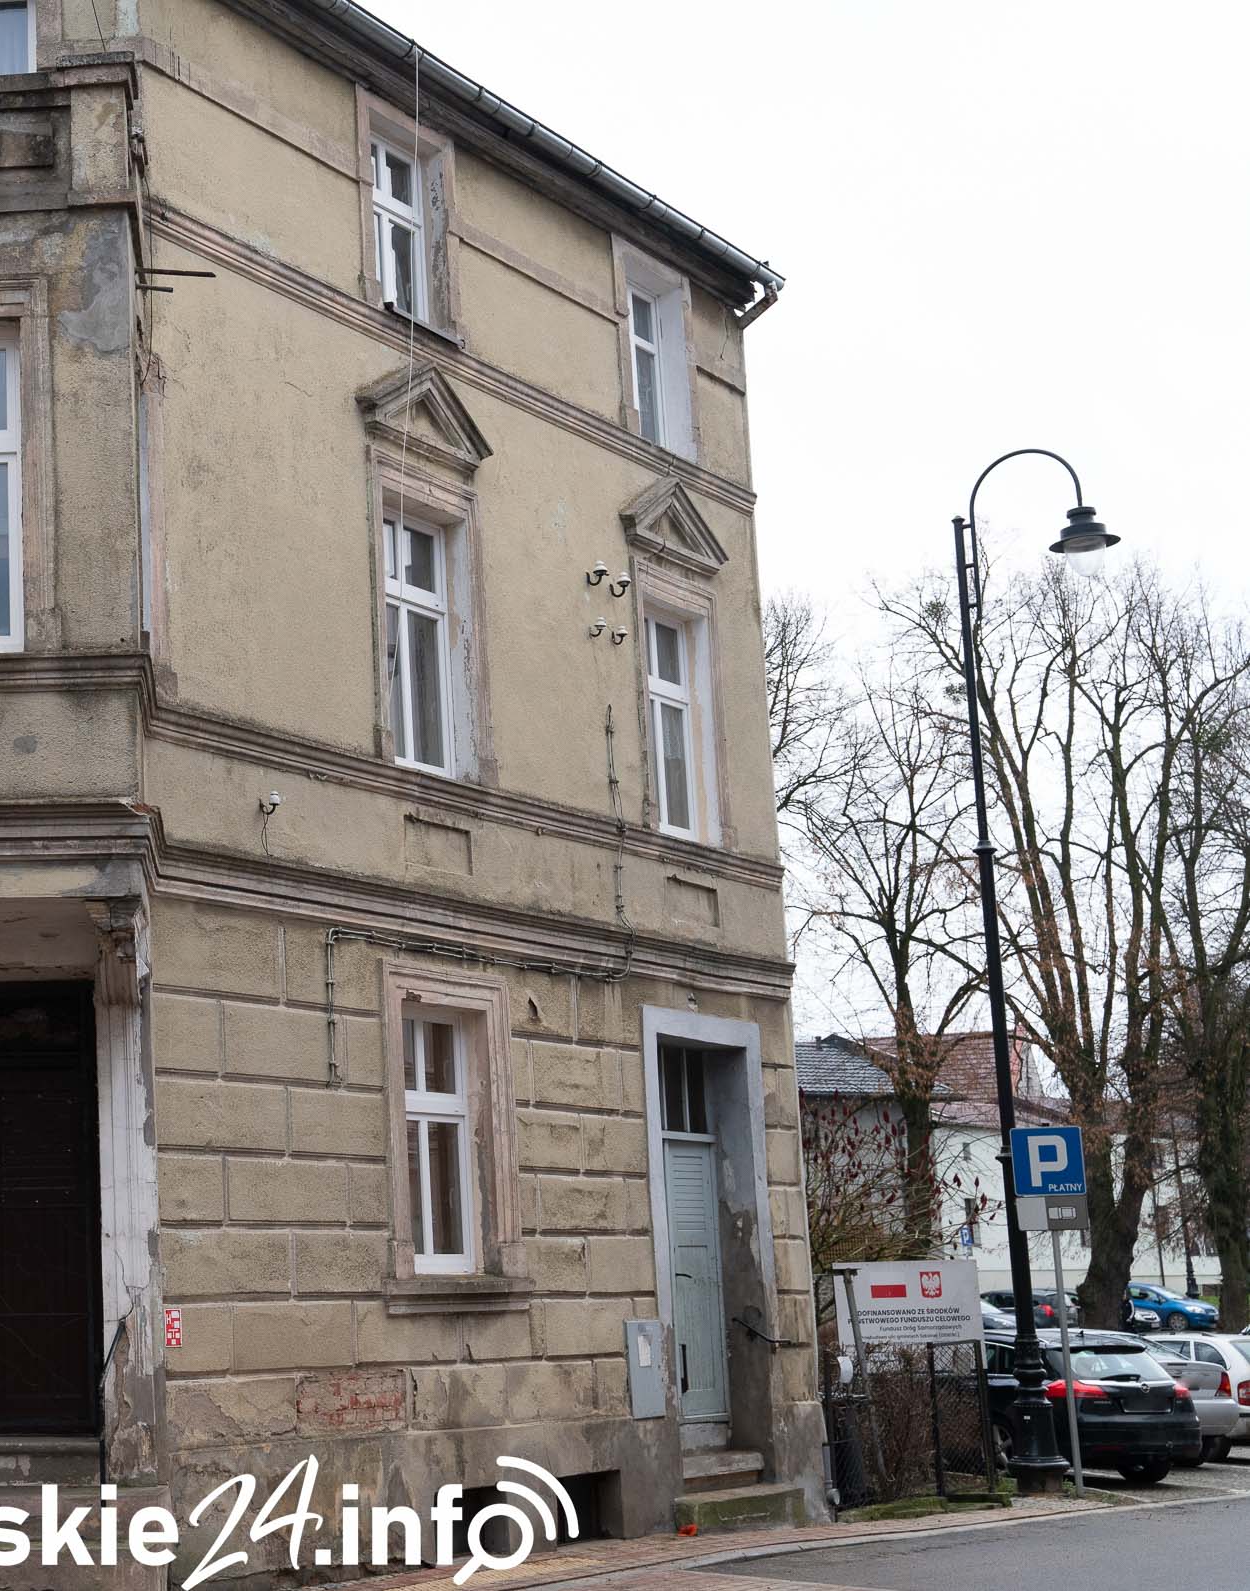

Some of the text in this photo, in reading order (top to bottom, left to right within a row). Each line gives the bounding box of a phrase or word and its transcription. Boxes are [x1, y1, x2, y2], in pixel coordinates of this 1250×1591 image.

[1027, 1135, 1069, 1187] P
[1048, 1183, 1083, 1193] PŁATNY
[857, 1309, 916, 1317] DOFINANSOWANO
[926, 1306, 960, 1315] ŚRODKÓW
[848, 1317, 899, 1325] PSTWOWEGO
